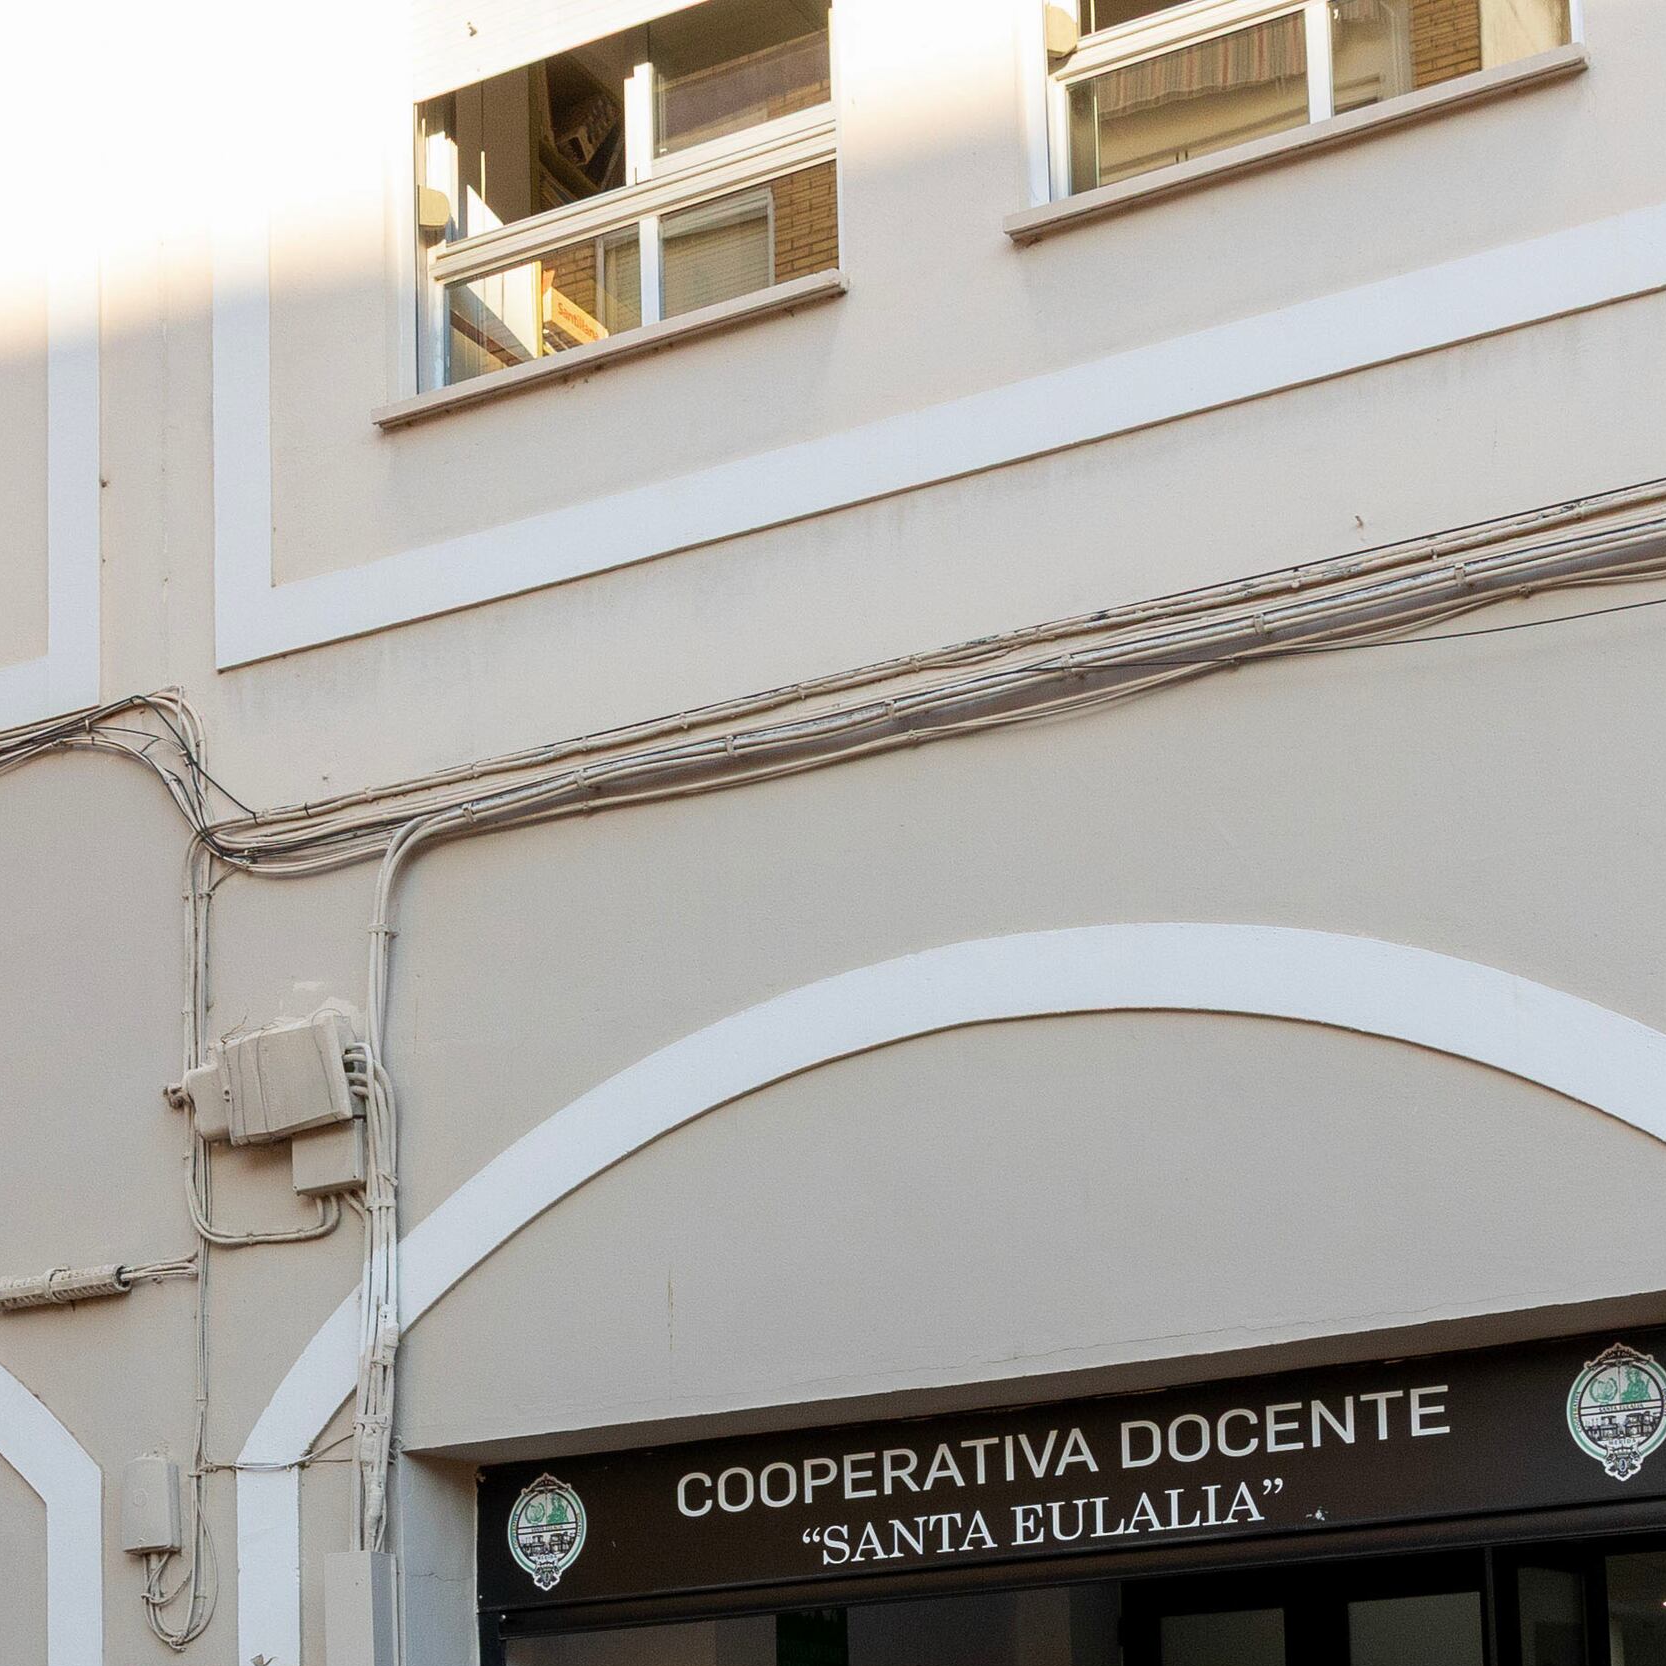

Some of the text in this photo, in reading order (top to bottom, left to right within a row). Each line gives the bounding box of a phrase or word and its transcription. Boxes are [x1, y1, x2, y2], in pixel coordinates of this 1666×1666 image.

[677, 1384, 1451, 1518] COOPERATIVA DOCENTE
[802, 1477, 1284, 1566] “SANTA EULALIA”
